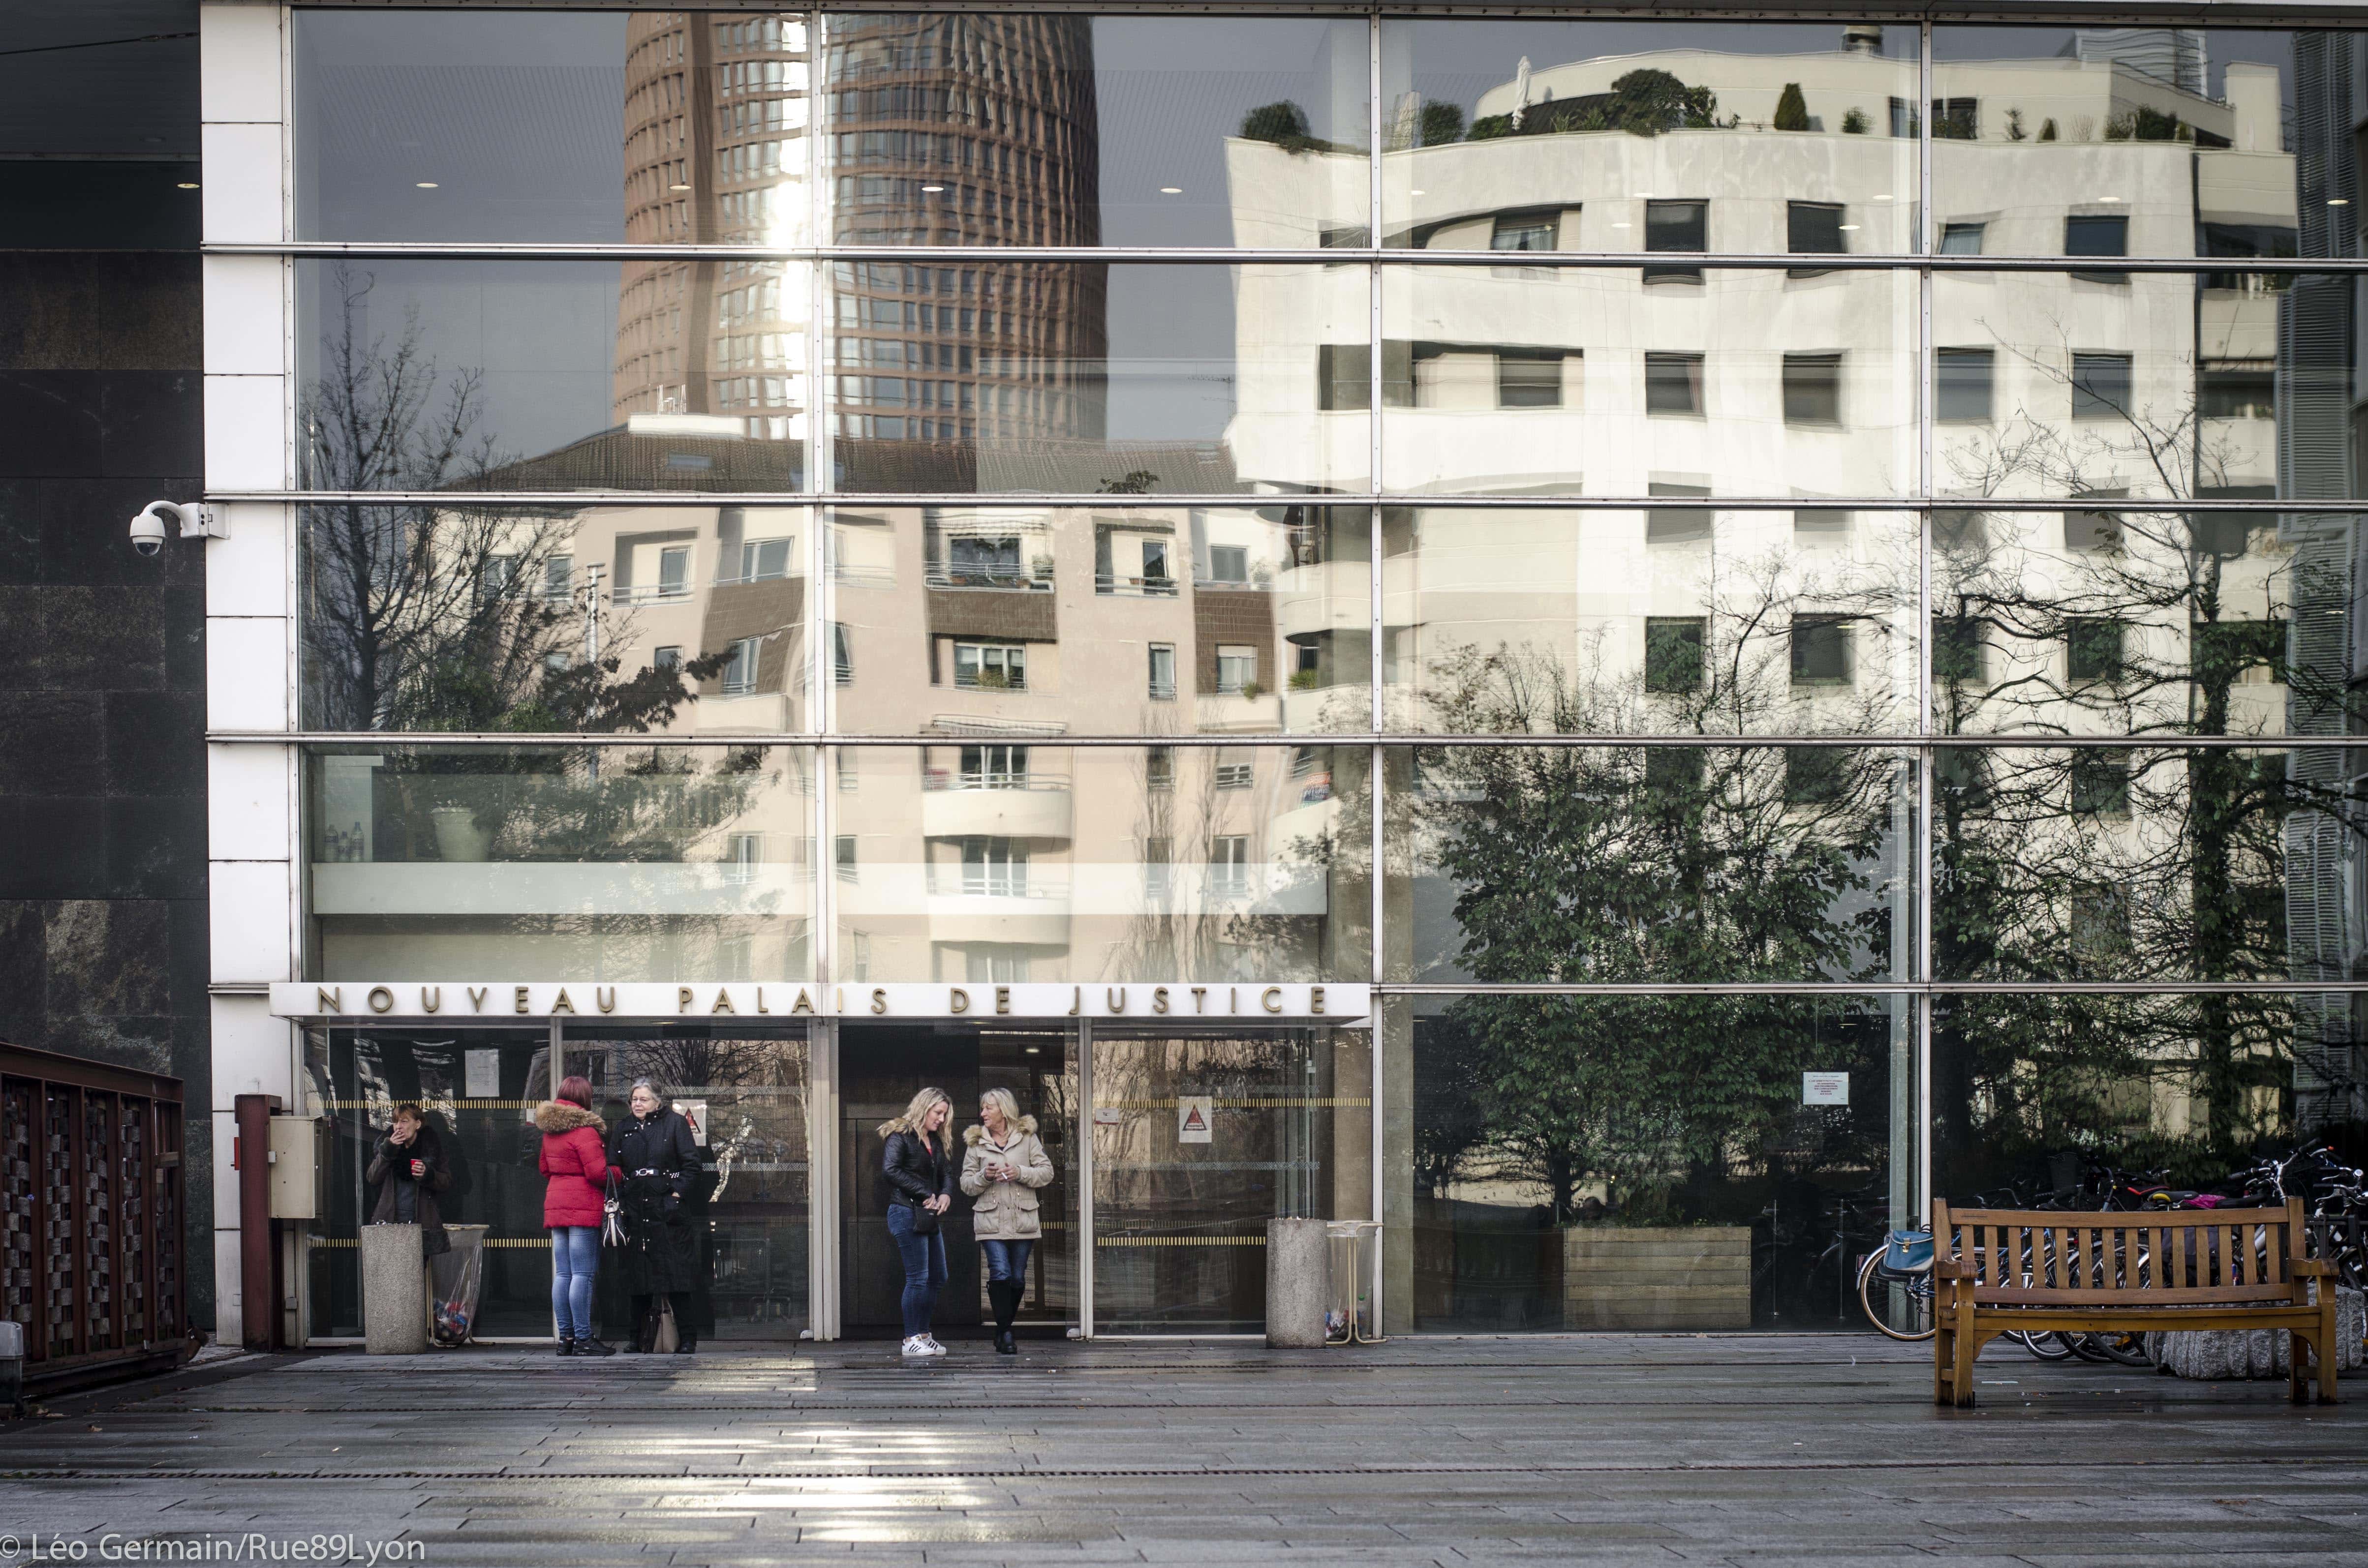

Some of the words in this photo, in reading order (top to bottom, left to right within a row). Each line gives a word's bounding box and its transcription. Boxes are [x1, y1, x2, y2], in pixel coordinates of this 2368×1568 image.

[318, 986, 616, 1014] NOUVEAU
[678, 987, 887, 1014] PALAIS
[950, 986, 1011, 1014] DE
[1069, 986, 1325, 1014] JUSTICE
